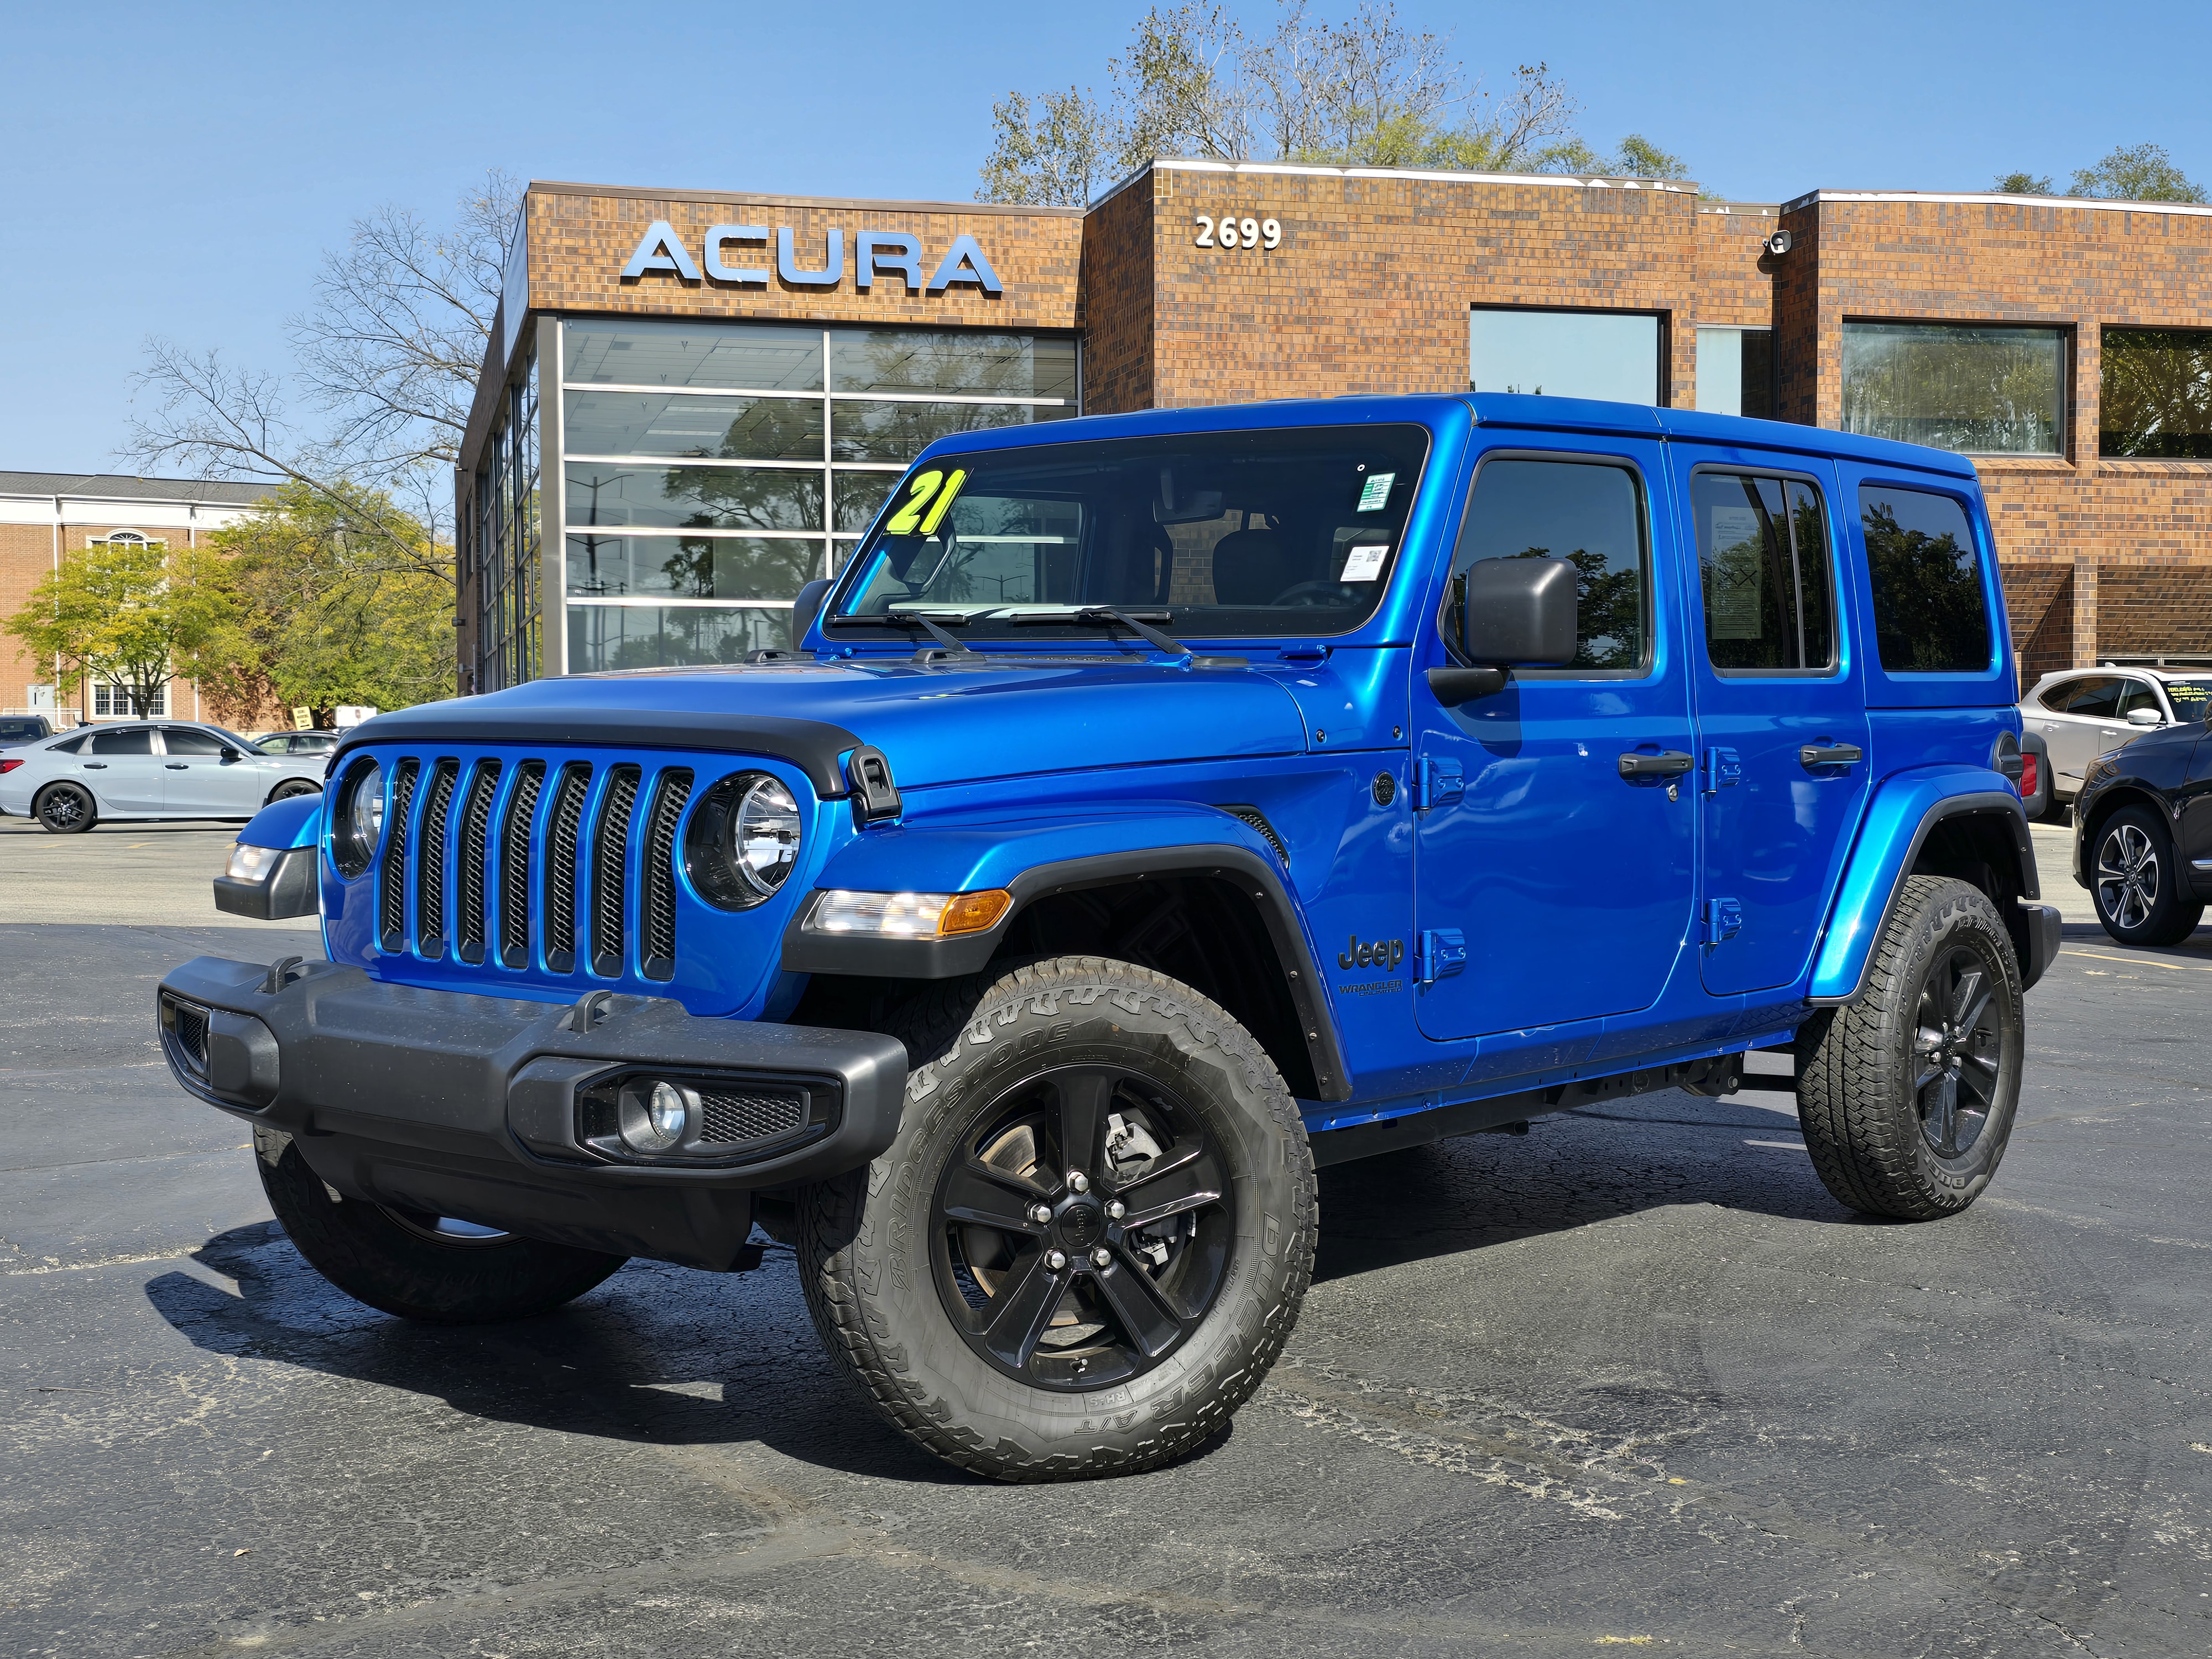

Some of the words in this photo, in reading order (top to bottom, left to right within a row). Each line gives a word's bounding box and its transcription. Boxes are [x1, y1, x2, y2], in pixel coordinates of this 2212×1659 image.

[621, 220, 1004, 294] ACURA
[1196, 216, 1282, 250] 2699
[886, 469, 966, 535] 21
[1338, 934, 1404, 972] Jeep
[1339, 979, 1402, 994] WRANGLER
[886, 1019, 1072, 1292] BRIDGESTONE
[1151, 1212, 1281, 1422] DUELER
[1074, 1410, 1138, 1435] A/T
